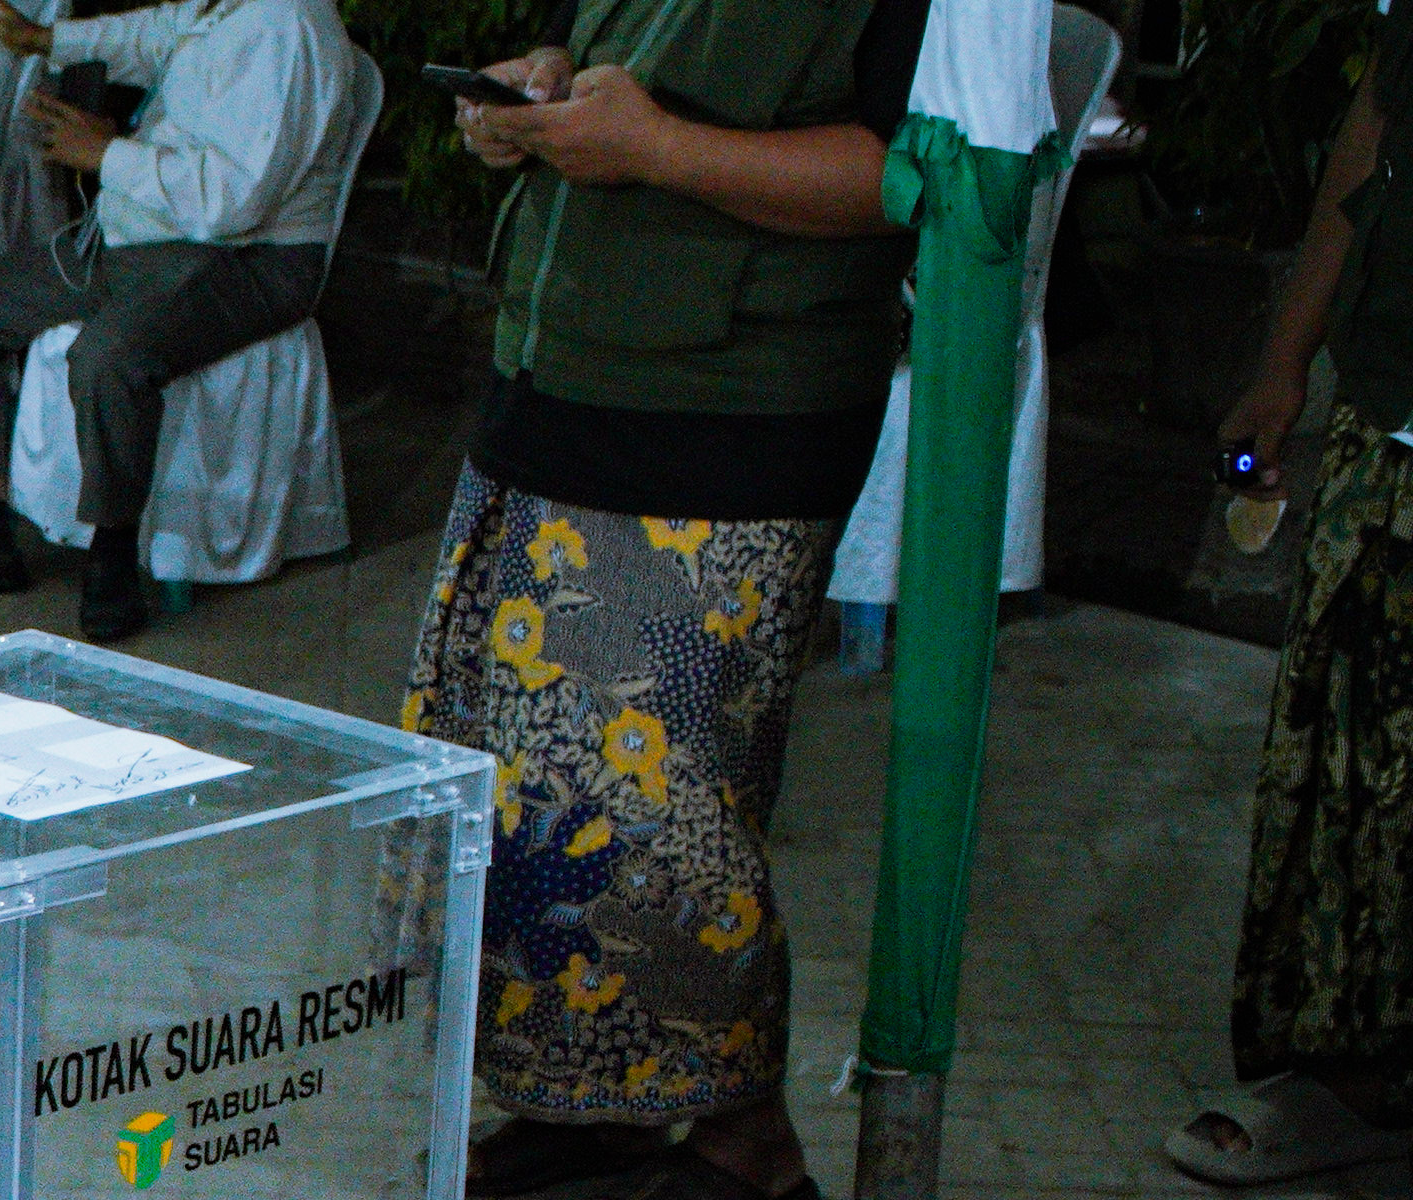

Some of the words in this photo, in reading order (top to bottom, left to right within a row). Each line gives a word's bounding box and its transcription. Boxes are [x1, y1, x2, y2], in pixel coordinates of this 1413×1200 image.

[34, 1032, 154, 1118] KOTAK
[164, 1000, 284, 1083] SUARA
[298, 967, 407, 1048] RESMI
[186, 1068, 324, 1129] TABULASI
[184, 1122, 281, 1172] SUARA
